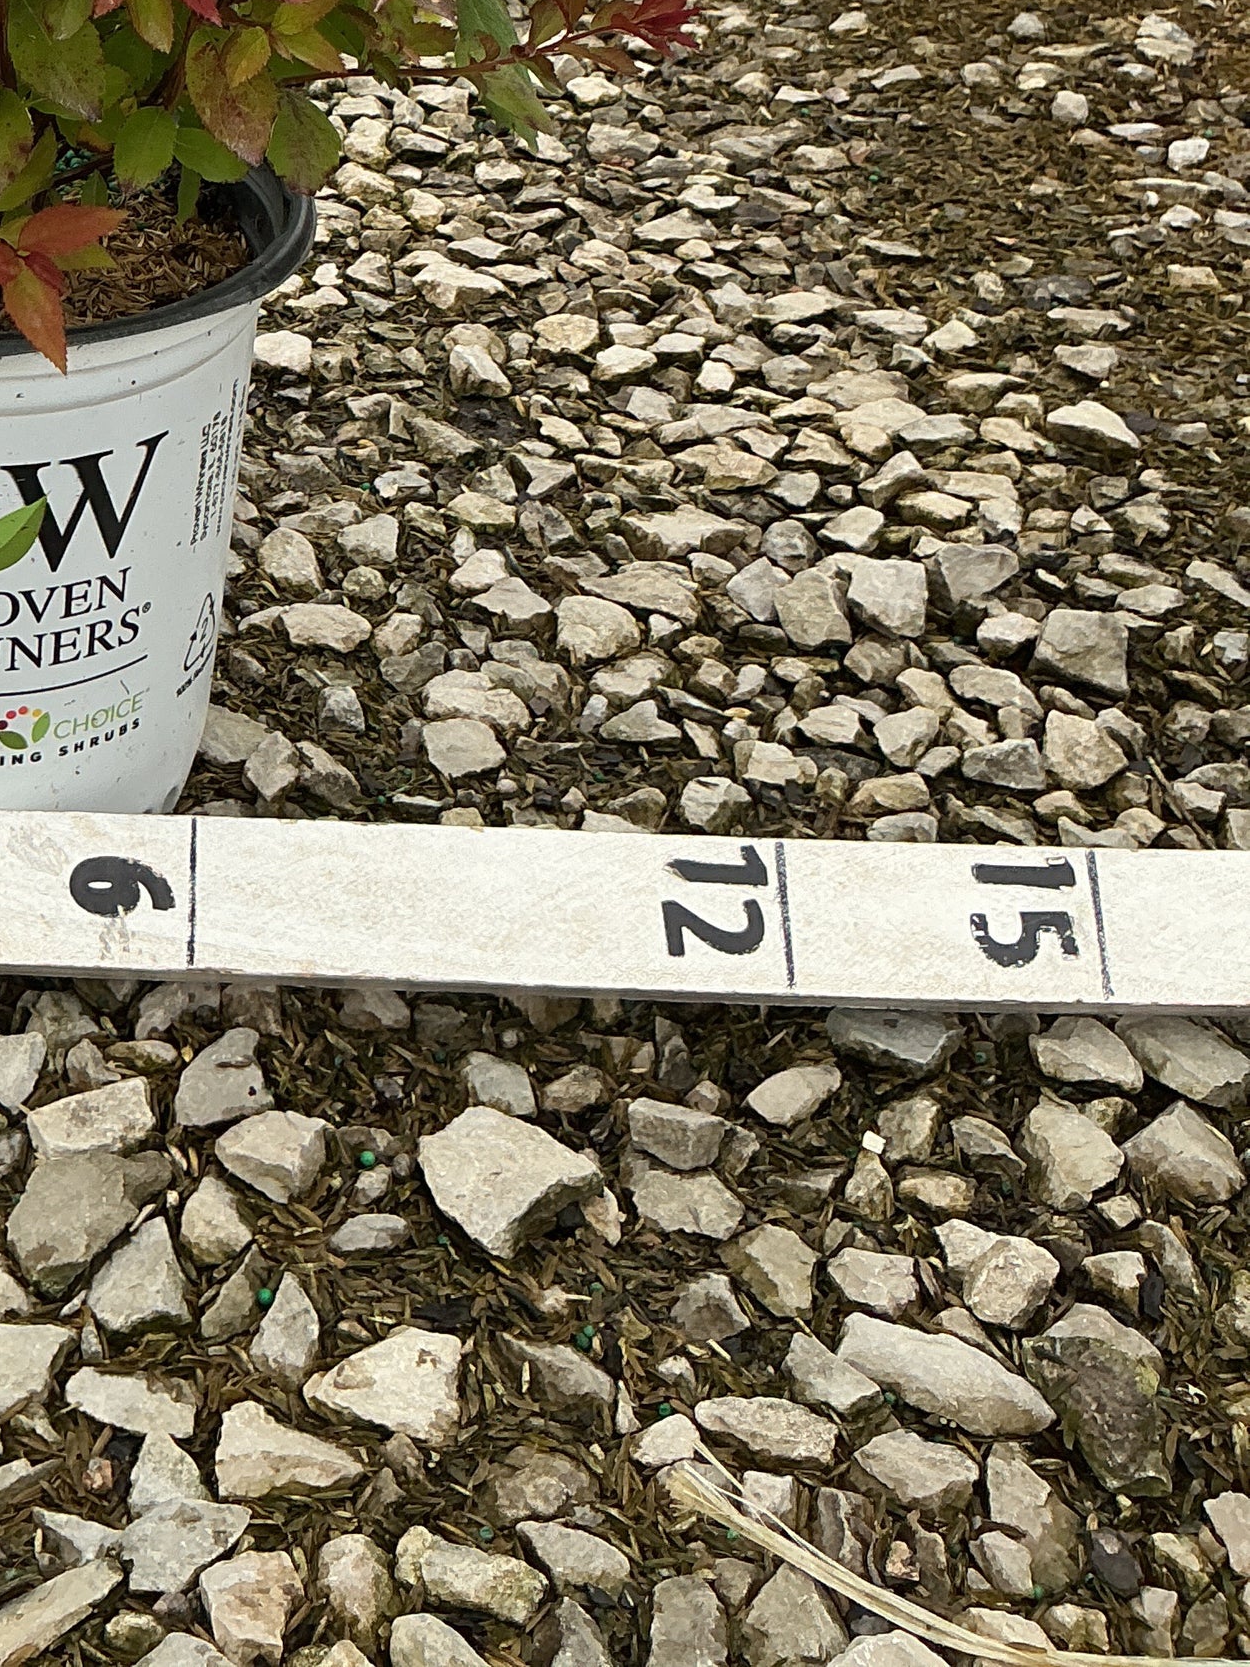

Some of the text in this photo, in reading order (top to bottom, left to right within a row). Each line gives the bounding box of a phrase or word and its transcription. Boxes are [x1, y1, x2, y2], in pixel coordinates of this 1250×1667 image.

[53, 690, 144, 740] CHOICE
[58, 717, 141, 757] SHRUBS
[69, 855, 176, 918] 6
[661, 844, 769, 958] 12
[970, 856, 1080, 968] 15
